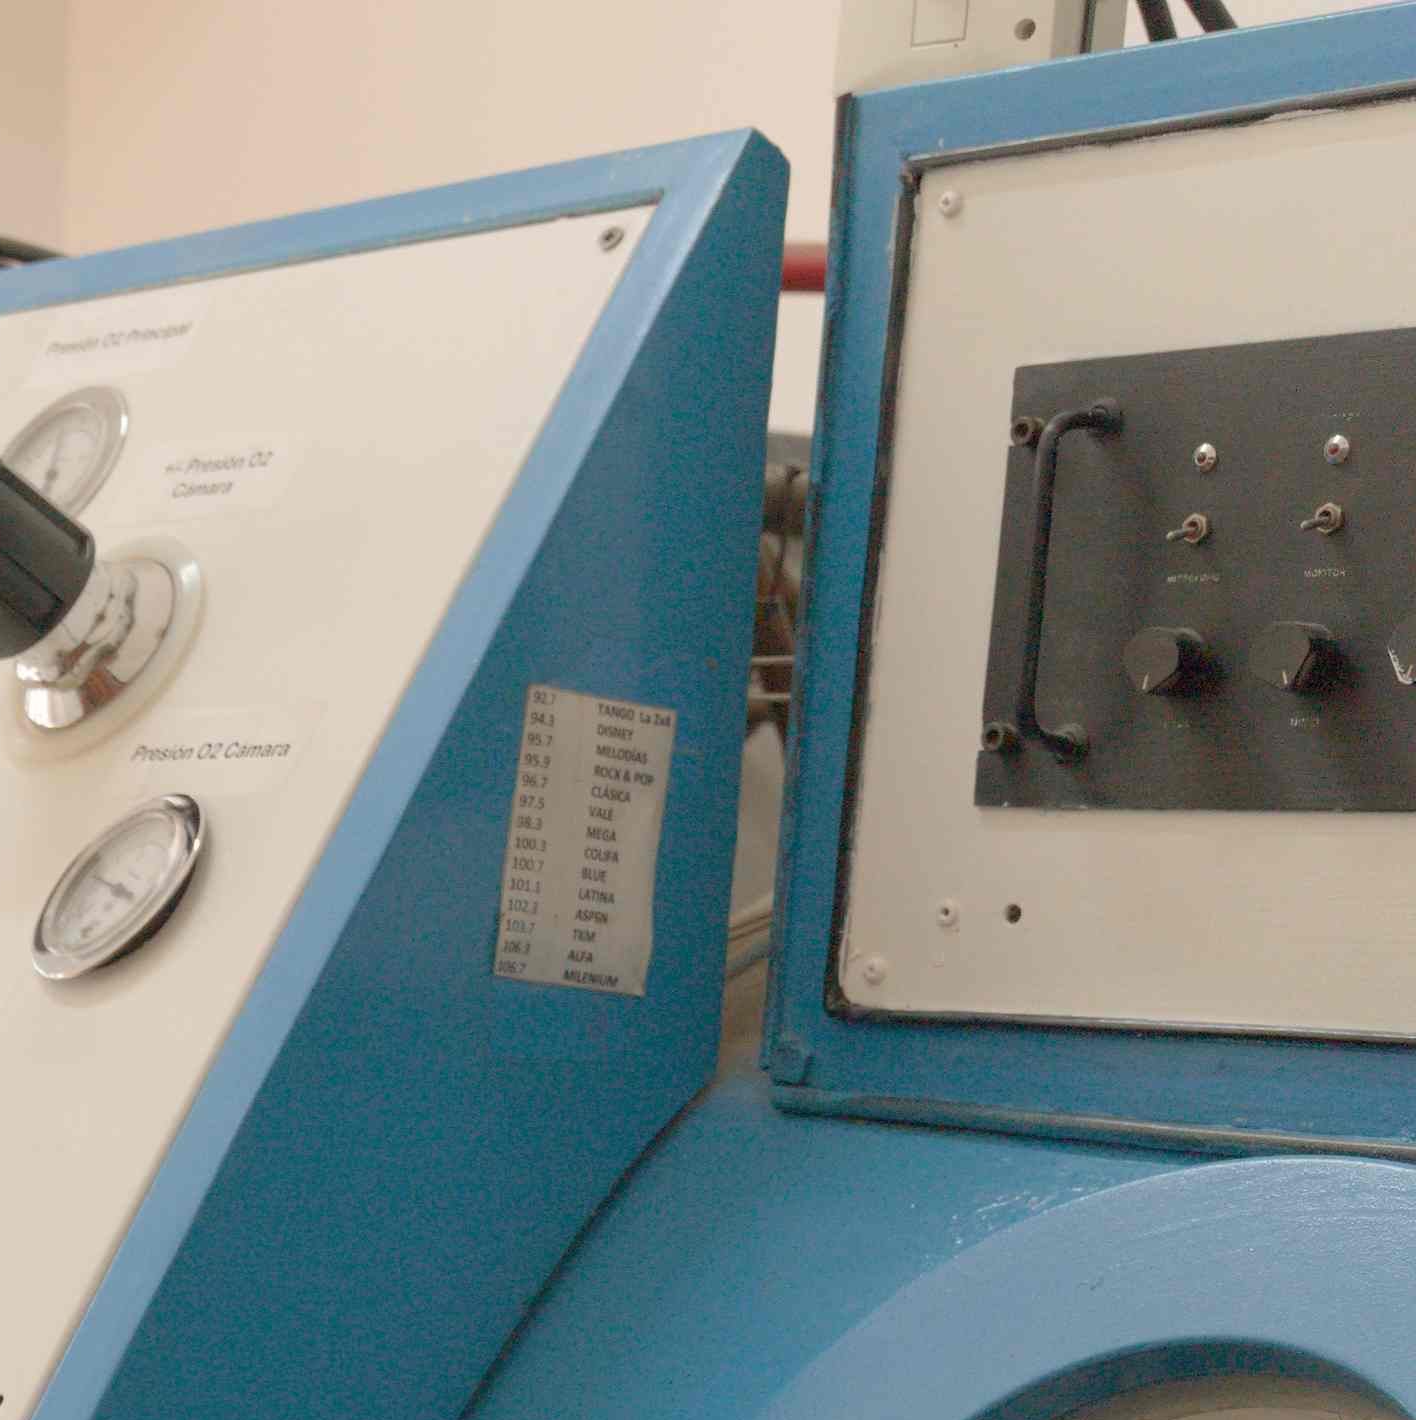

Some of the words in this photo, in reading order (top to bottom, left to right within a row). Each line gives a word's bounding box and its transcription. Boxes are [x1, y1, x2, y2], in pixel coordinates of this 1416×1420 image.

[1303, 567, 1346, 579] MONITOR
[596, 703, 635, 722] TANGO
[530, 711, 555, 728] 94.3
[596, 723, 634, 741] DISNEY
[527, 731, 553, 747] 95.7
[130, 743, 195, 762] Presión
[524, 752, 551, 769] 95.9
[593, 764, 620, 781] ROCK
[622, 770, 631, 783] &
[633, 772, 655, 787] POP
[521, 773, 548, 789] 96.7
[591, 784, 631, 803] CLÁSICA
[518, 794, 545, 810] 97.5
[588, 805, 614, 822] VALE
[585, 825, 617, 843] MEGA
[512, 856, 545, 872] 100.7
[581, 867, 607, 883] BLUE
[509, 877, 541, 894] 101.1
[578, 887, 615, 905] LATINA
[575, 909, 609, 925] ASPEN
[567, 949, 593, 963] ALFA
[562, 967, 619, 987] MILENIUM
